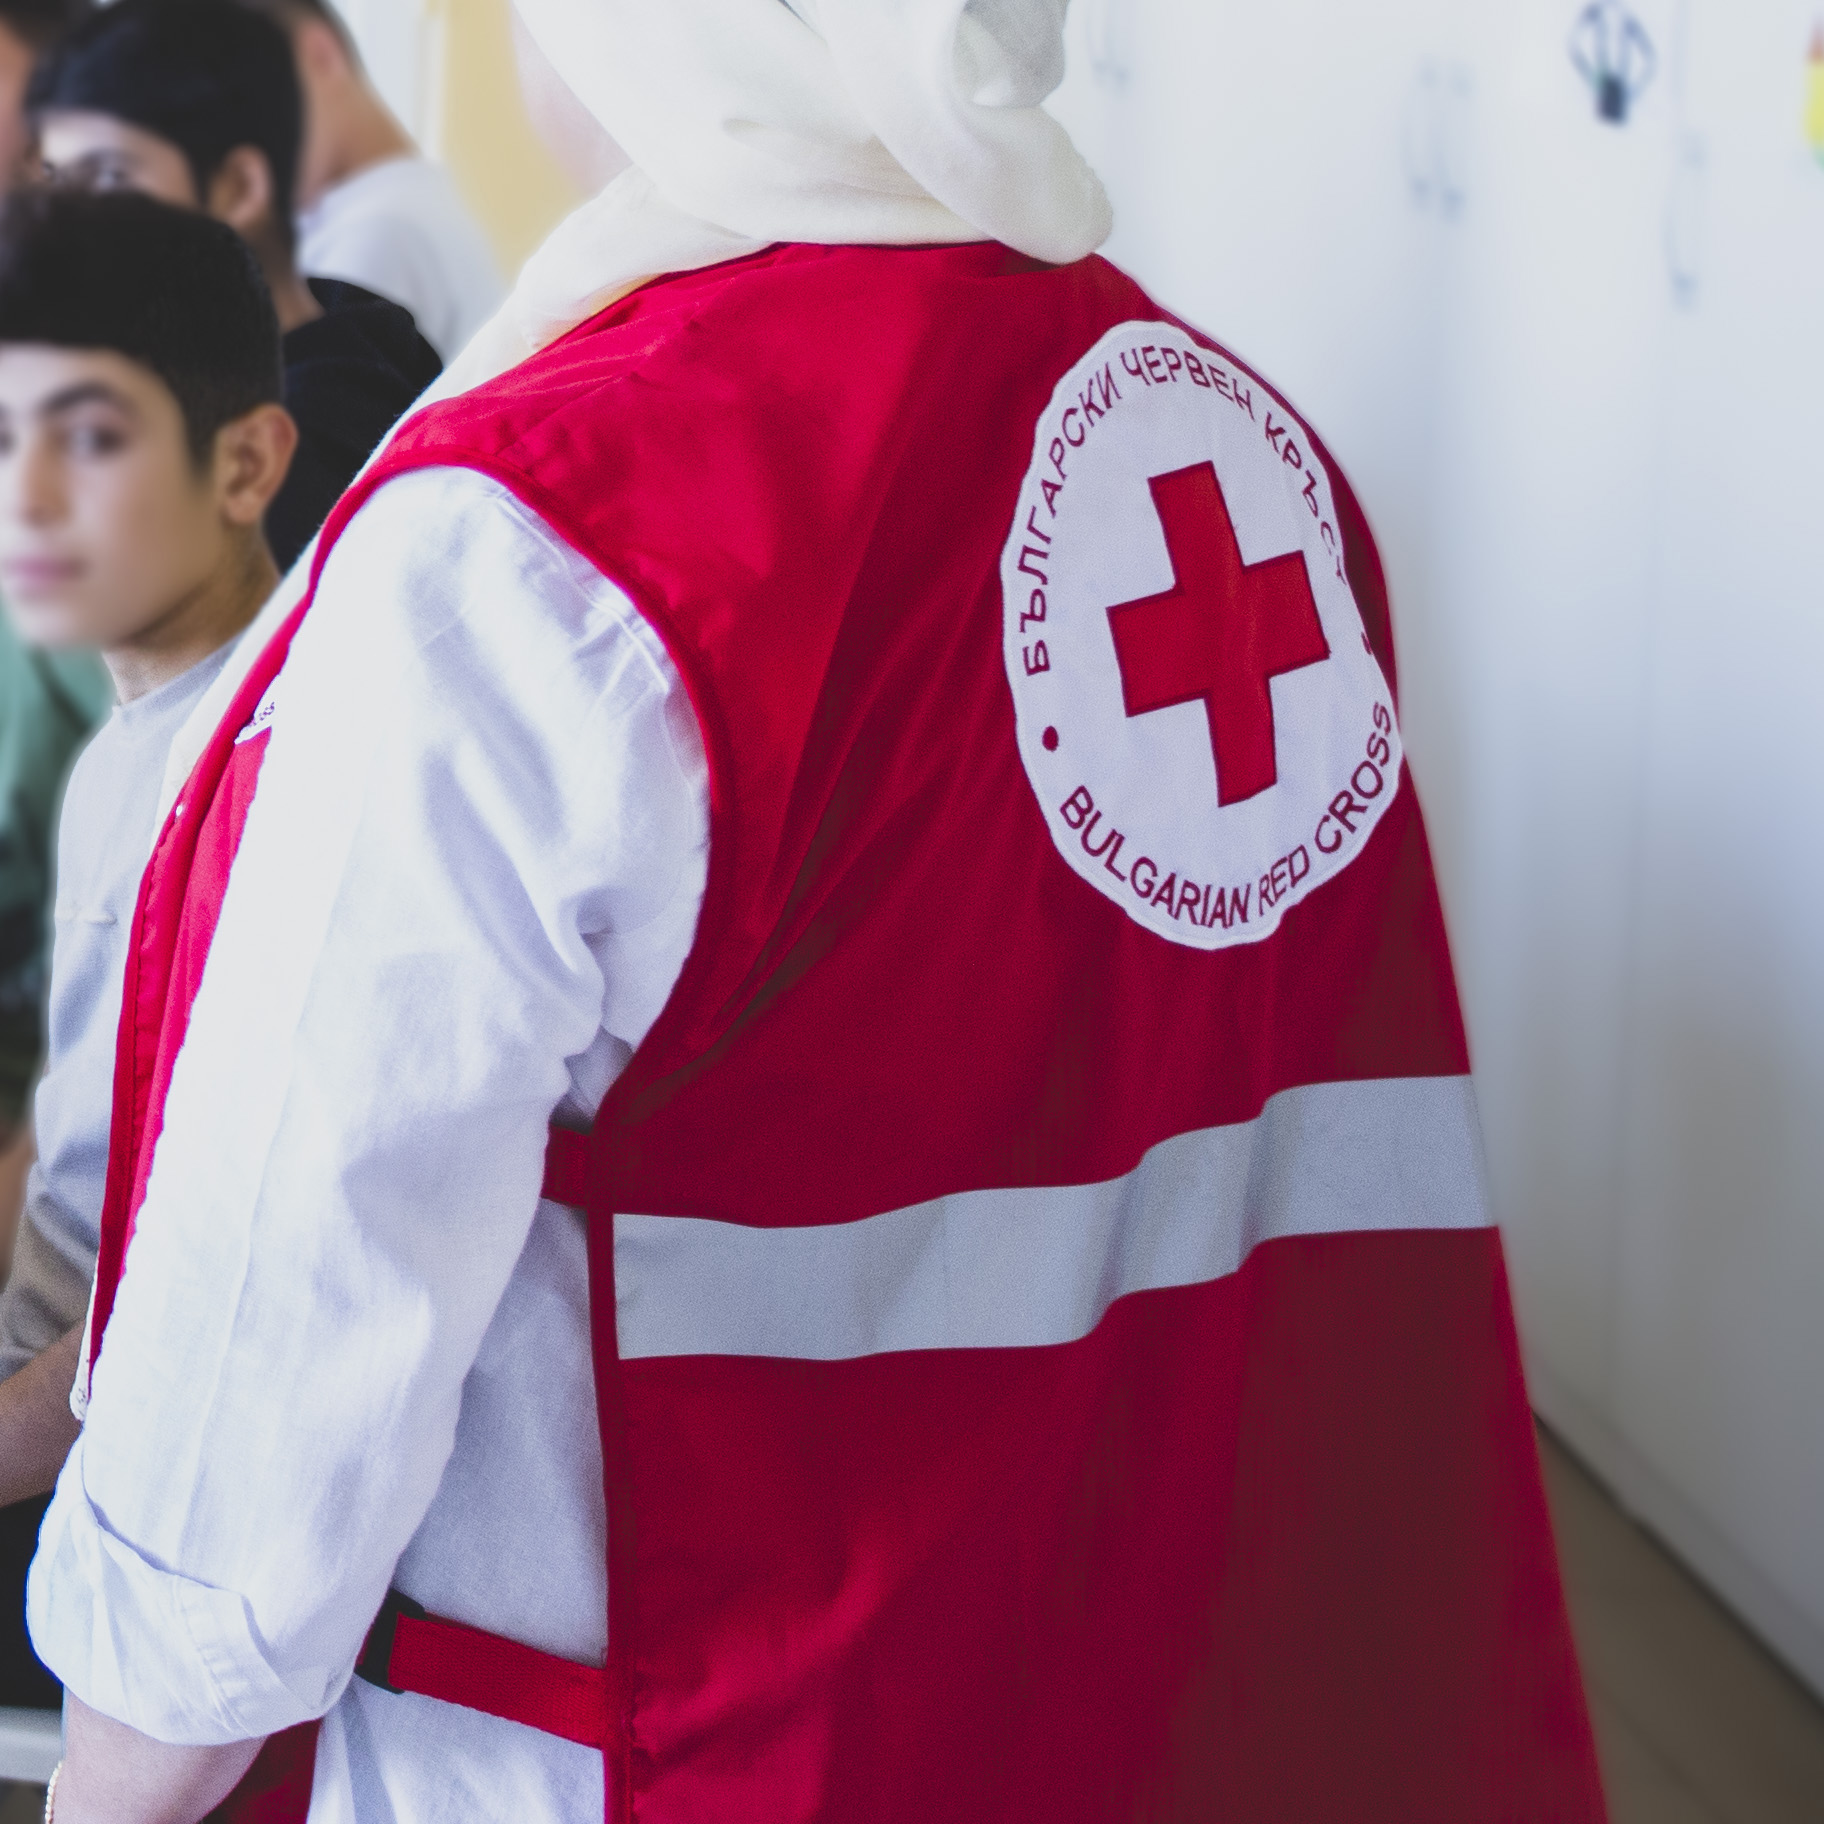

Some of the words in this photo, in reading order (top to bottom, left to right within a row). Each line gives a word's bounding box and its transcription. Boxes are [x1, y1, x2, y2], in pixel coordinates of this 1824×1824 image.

[1017, 362, 1122, 676] БЪЛГАРСКИ
[1120, 345, 1255, 422] ЧЕРВЕН
[1059, 784, 1252, 928] BULGARIAN
[1258, 844, 1311, 916] RED
[1314, 701, 1392, 856] CROSS
